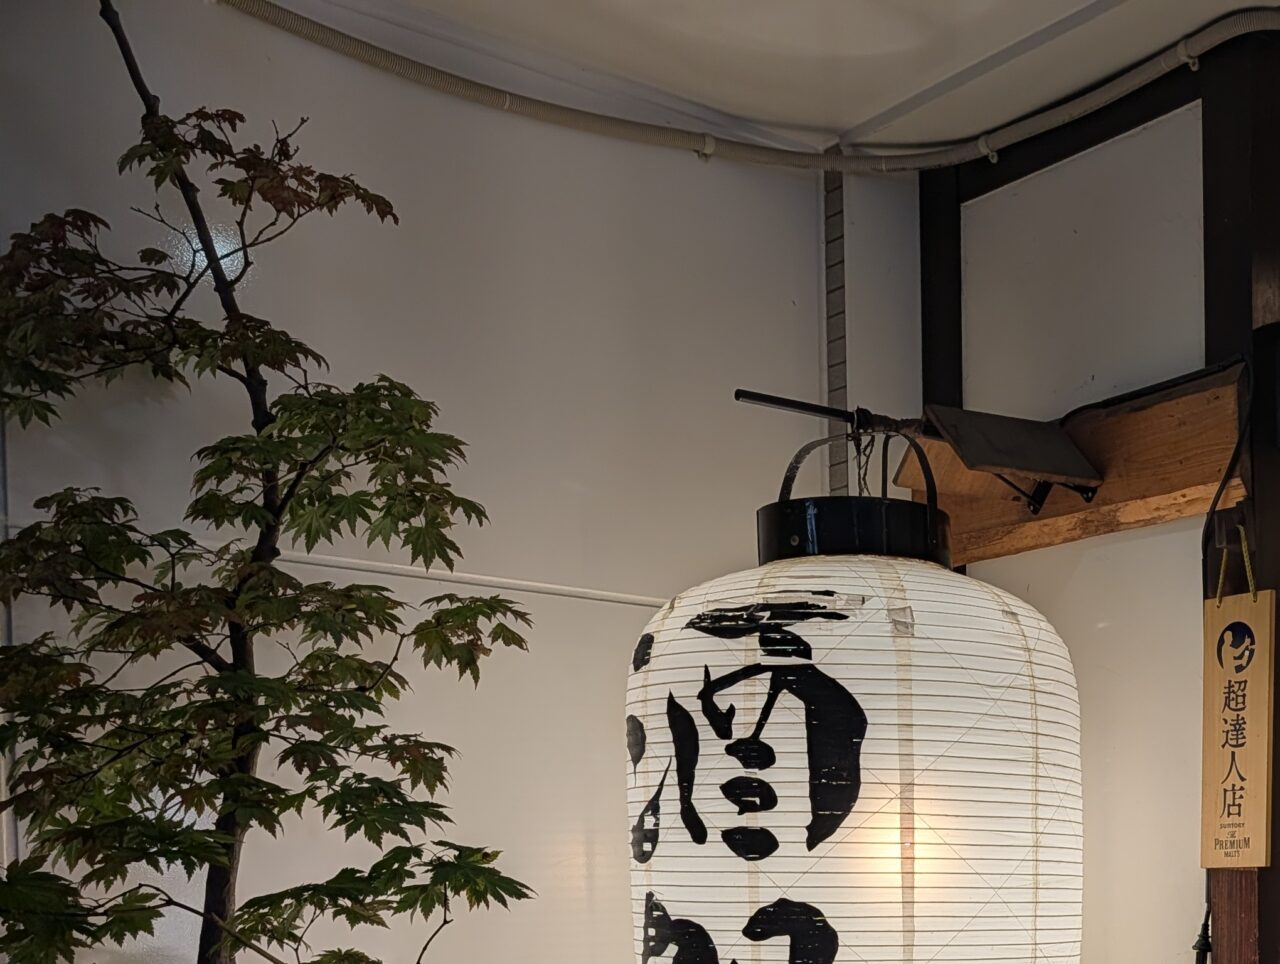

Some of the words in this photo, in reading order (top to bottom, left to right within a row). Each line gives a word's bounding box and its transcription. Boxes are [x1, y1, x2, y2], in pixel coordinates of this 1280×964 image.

[1219, 679, 1249, 819] 超達人店
[1213, 837, 1251, 851] PREMIUM
